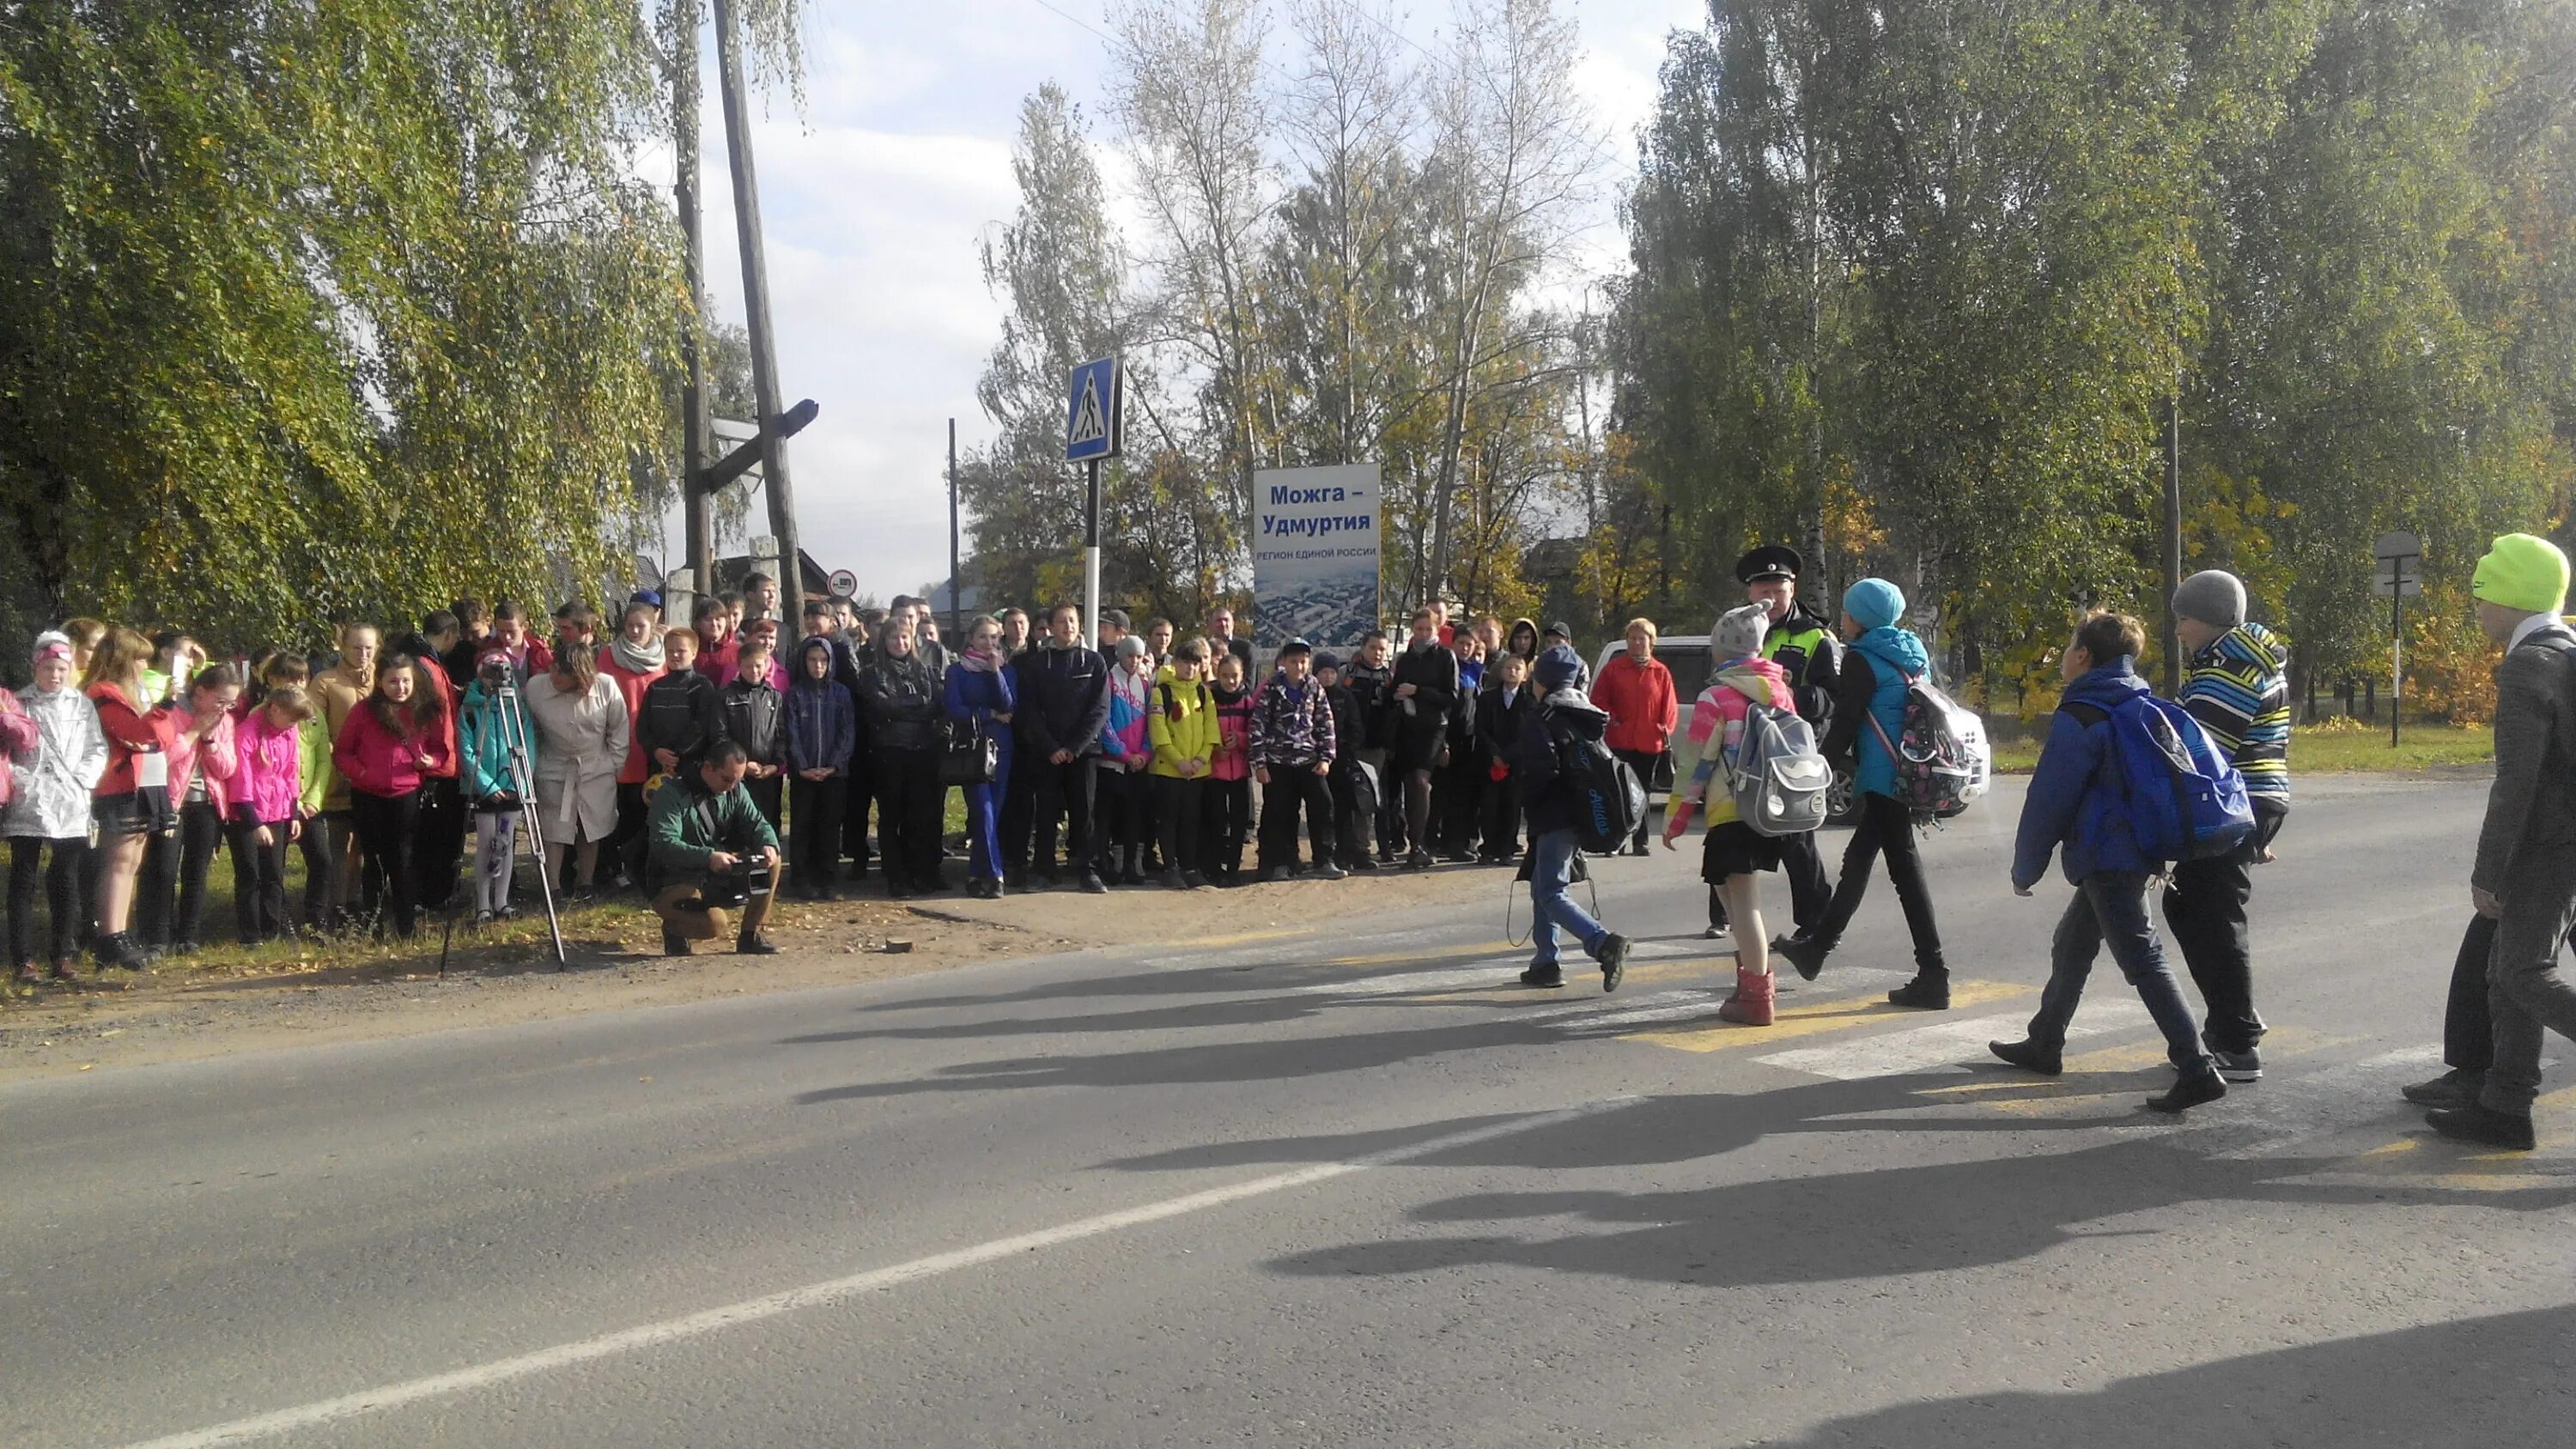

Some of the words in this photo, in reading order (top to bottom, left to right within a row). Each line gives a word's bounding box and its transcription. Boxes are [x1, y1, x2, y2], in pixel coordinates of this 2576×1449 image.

[1271, 485, 1345, 505] Можга
[1262, 515, 1370, 537] Удмуртия
[1256, 551, 1293, 561] РЕГИОН
[1296, 549, 1334, 560] ЕДИНОЙ
[1337, 548, 1376, 557] РОССИИ
